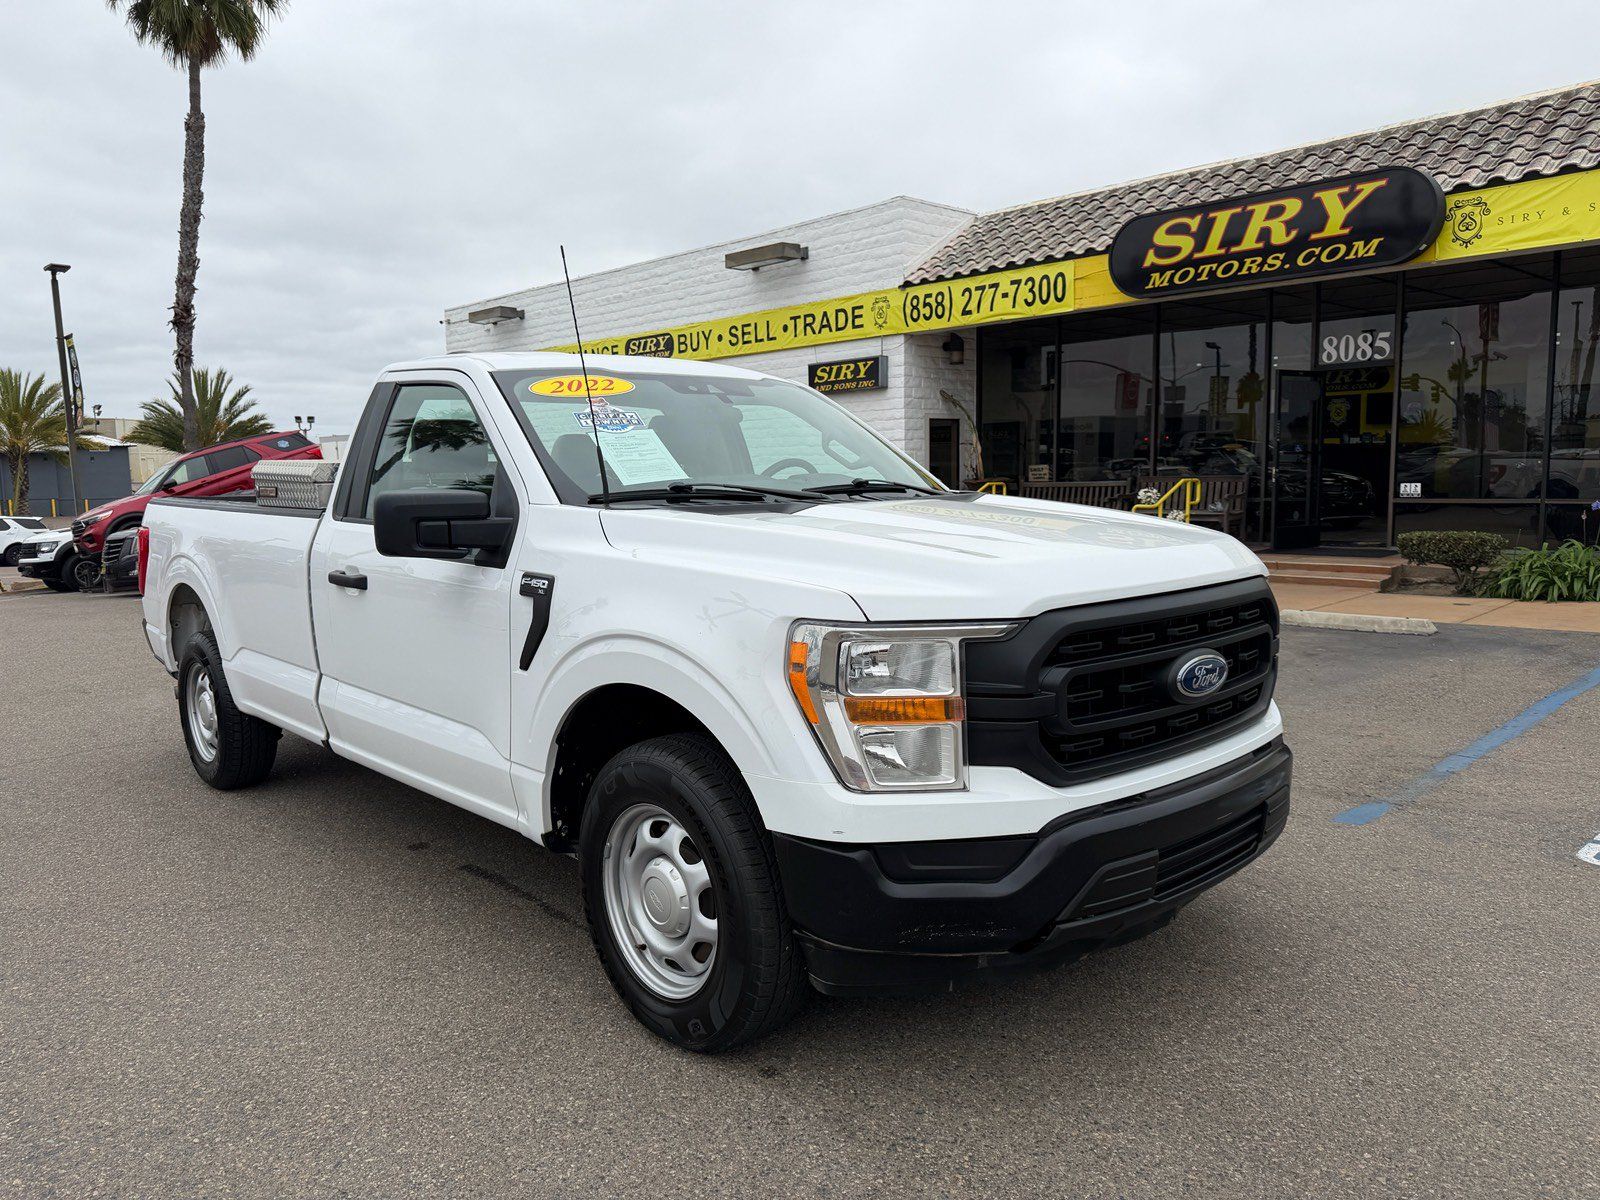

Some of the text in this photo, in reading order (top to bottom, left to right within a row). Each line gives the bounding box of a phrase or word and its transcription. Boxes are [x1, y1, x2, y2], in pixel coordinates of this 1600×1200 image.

[1142, 178, 1389, 268] SIRY
[1497, 210, 1546, 226] SIRY
[1561, 206, 1571, 216] &
[1145, 237, 1384, 290] MOTORS.COM
[902, 272, 1067, 327] (858) 277-7300
[677, 305, 864, 355] BUY SELL TRADE
[628, 335, 670, 355] SIRY
[1321, 331, 1392, 363] 8085
[814, 361, 875, 384] SIRY
[550, 379, 615, 394] 2022
[833, 381, 857, 391] SONS
[858, 380, 875, 388] INC
[521, 577, 549, 589] F-150
[1192, 663, 1220, 689] Ford
